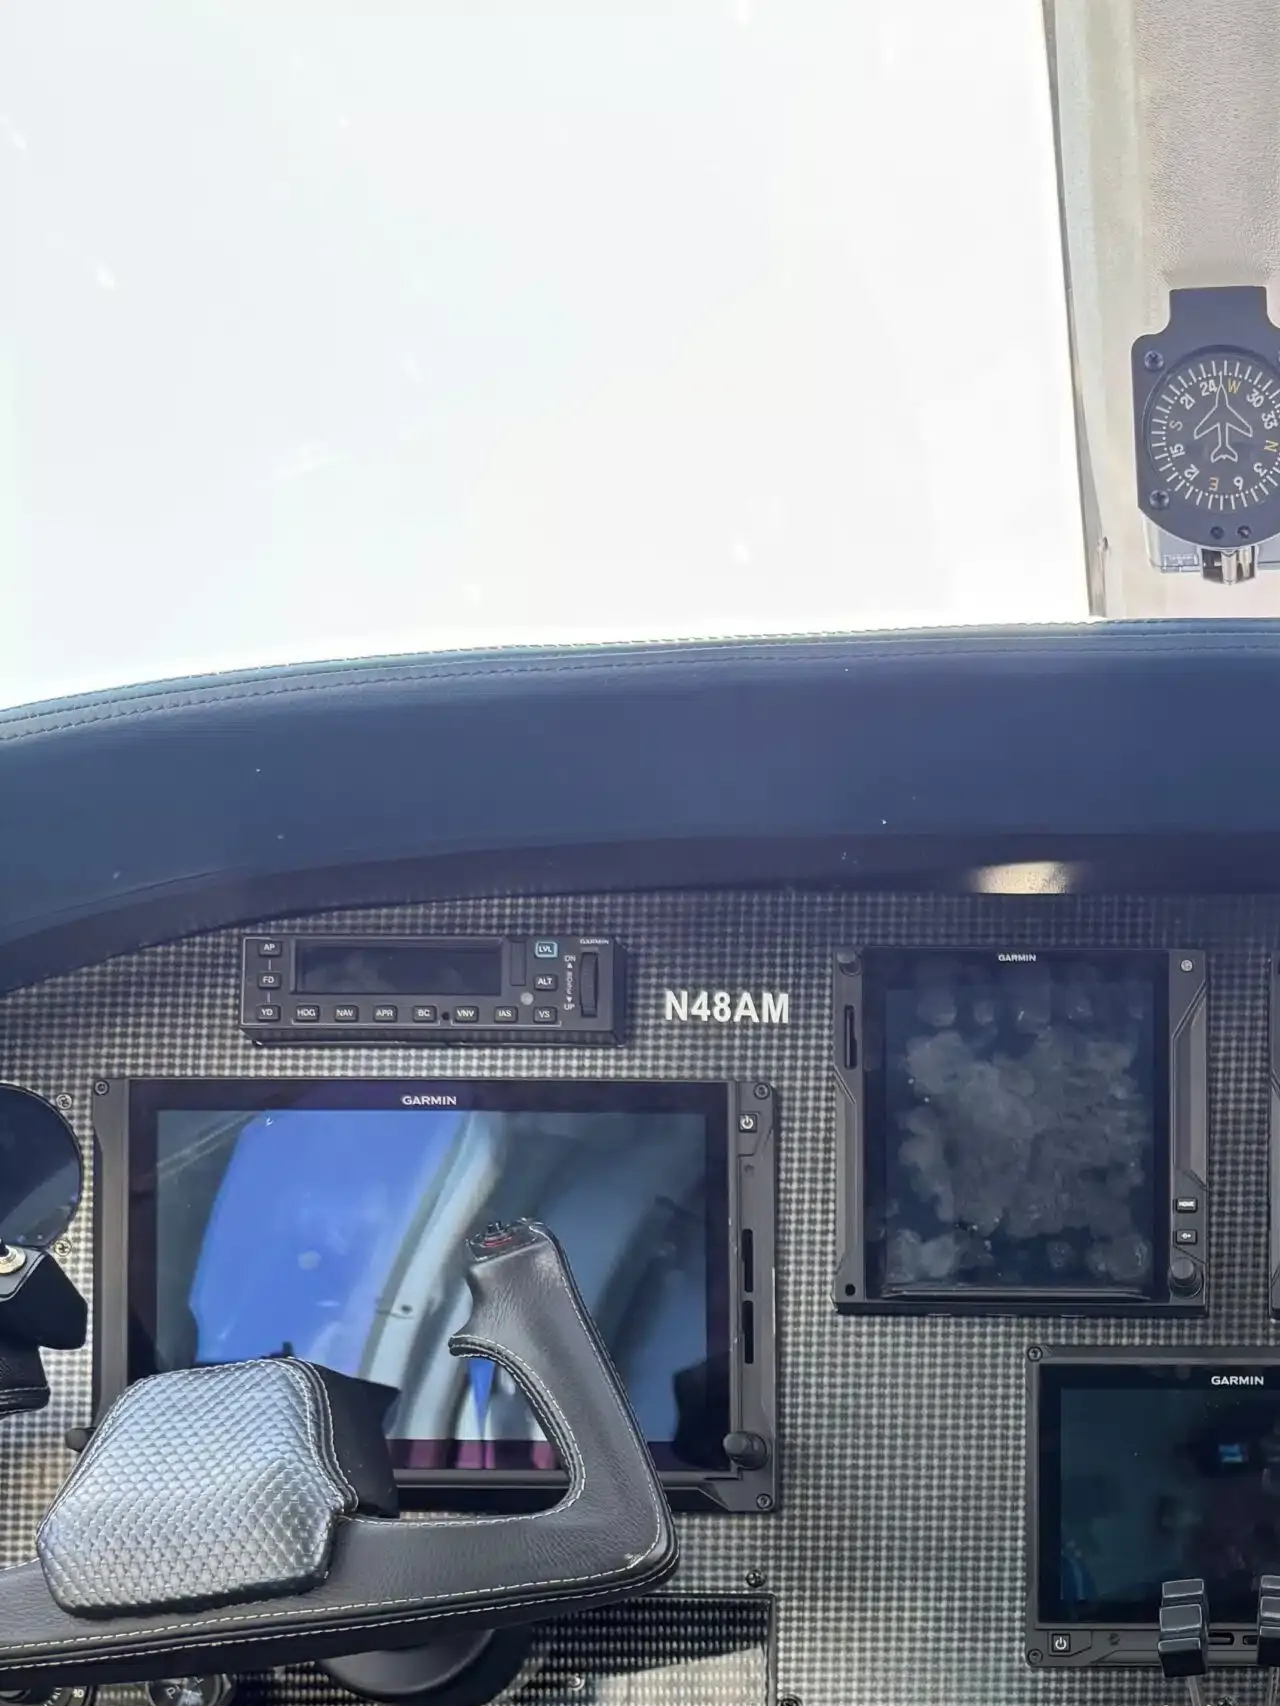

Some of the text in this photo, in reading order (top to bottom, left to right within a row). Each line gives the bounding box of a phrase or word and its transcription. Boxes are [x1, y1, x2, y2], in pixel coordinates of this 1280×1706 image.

[1200, 380, 1217, 397] 24
[1228, 379, 1241, 393] W
[1180, 393, 1196, 410] 21
[1246, 389, 1264, 408] 30
[1170, 420, 1183, 431] S
[1262, 411, 1277, 429] 33
[1170, 443, 1184, 457] 15
[1264, 440, 1279, 452] N
[1253, 462, 1266, 476] 3
[1210, 477, 1220, 490] E
[297, 1009, 316, 1017] HDG
[336, 1009, 353, 1017] NAV
[376, 1009, 393, 1017] APR
[665, 990, 789, 1023] N48AM
[402, 1096, 457, 1105] GARMIN
[1211, 1376, 1264, 1385] GARMIN
